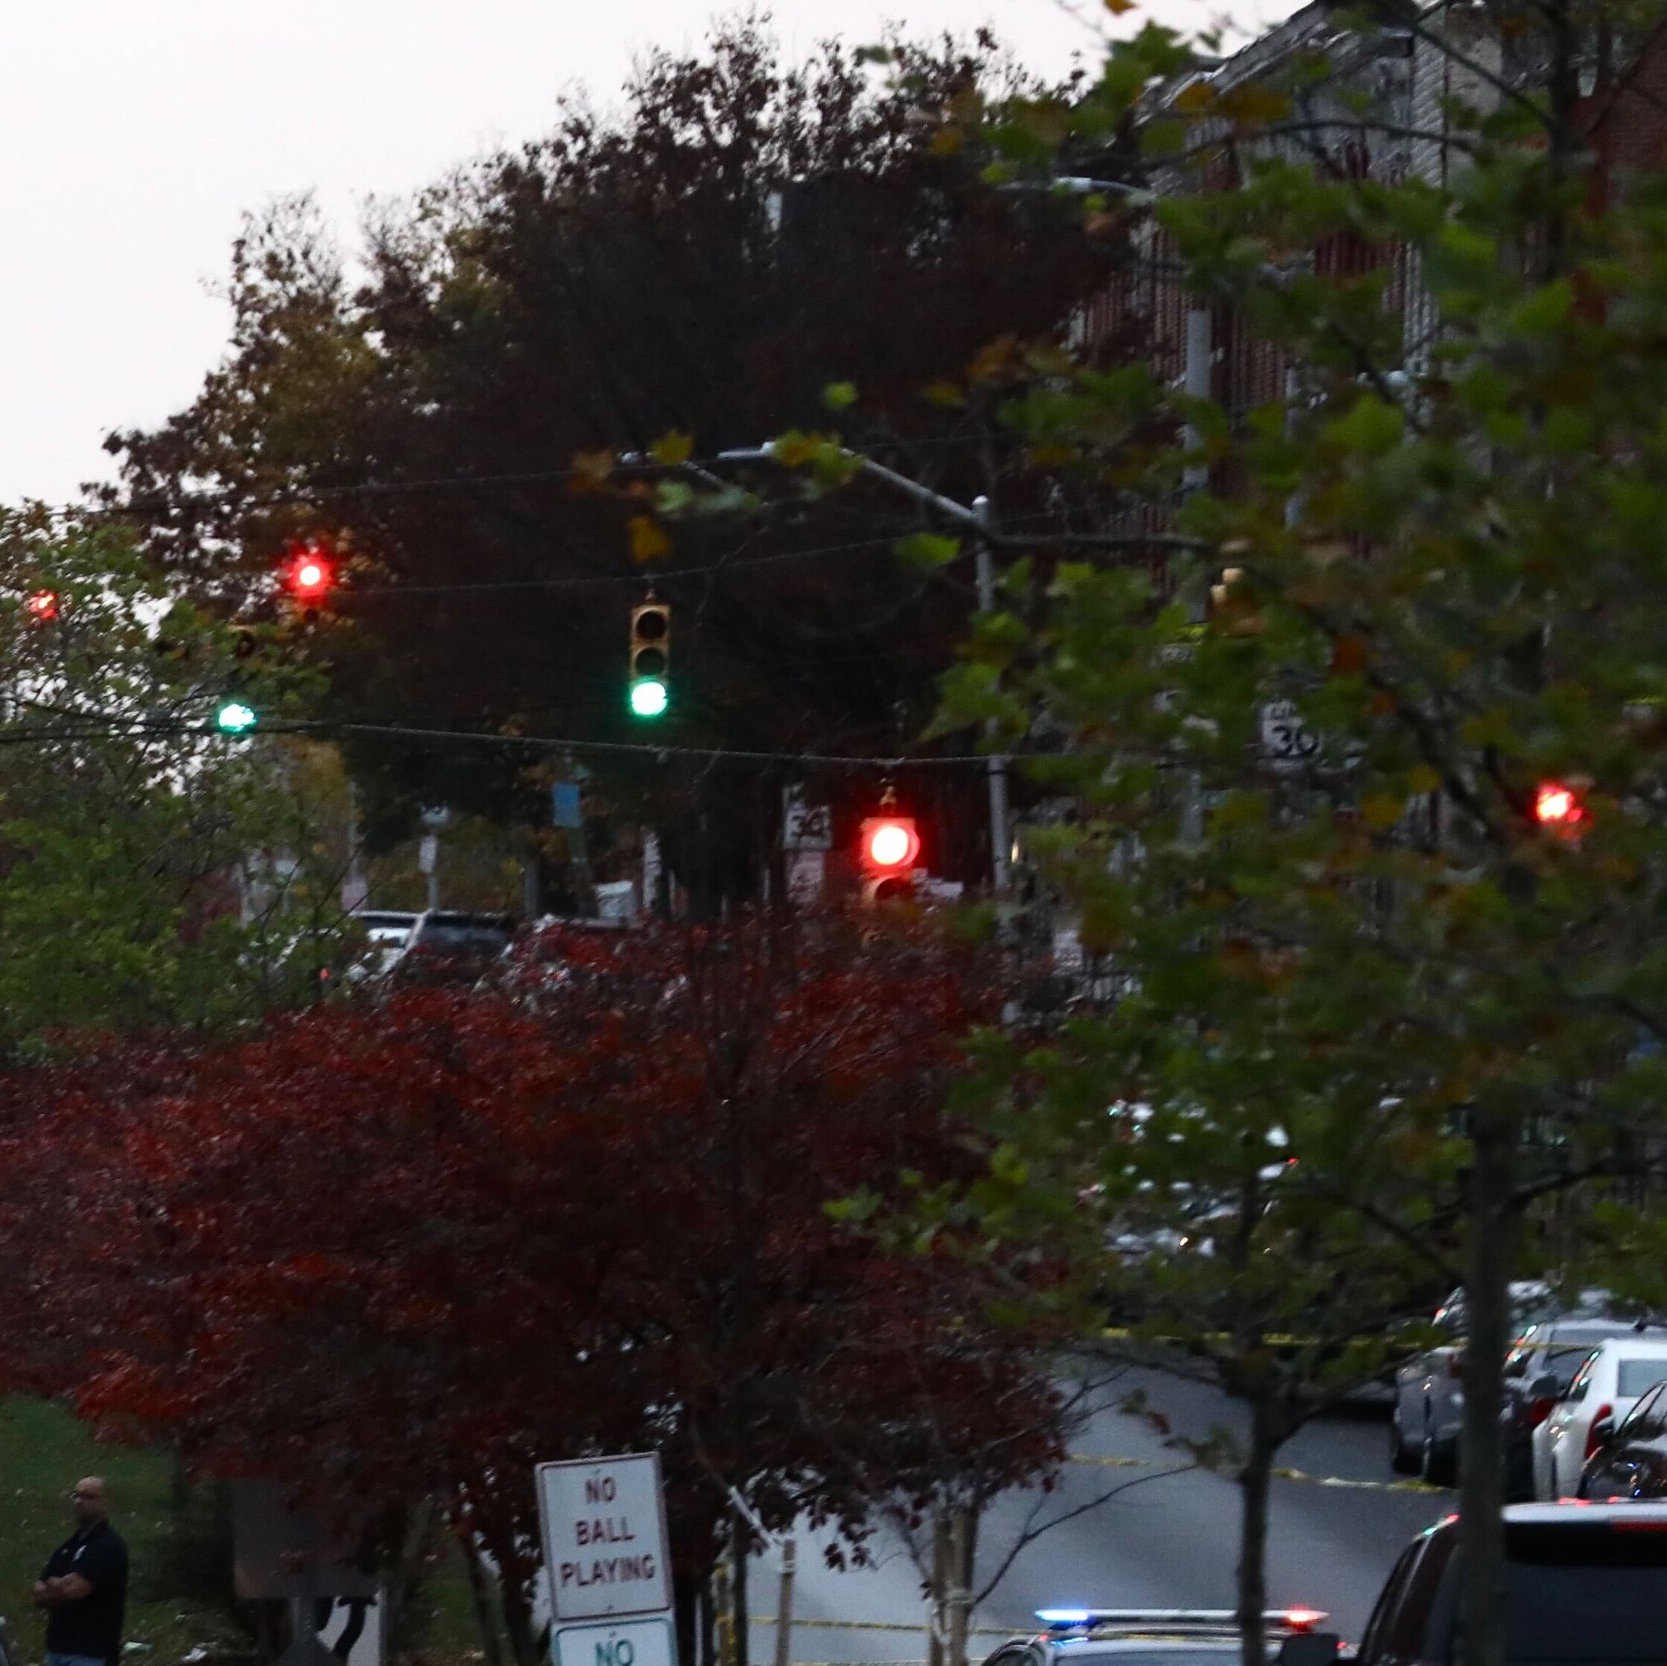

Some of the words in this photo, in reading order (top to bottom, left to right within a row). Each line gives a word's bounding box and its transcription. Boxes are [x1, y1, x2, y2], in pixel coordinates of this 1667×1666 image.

[1272, 726, 1319, 758] 30
[584, 1476, 617, 1504] NO
[576, 1516, 636, 1546] BALL
[560, 1554, 657, 1588] PLAYING
